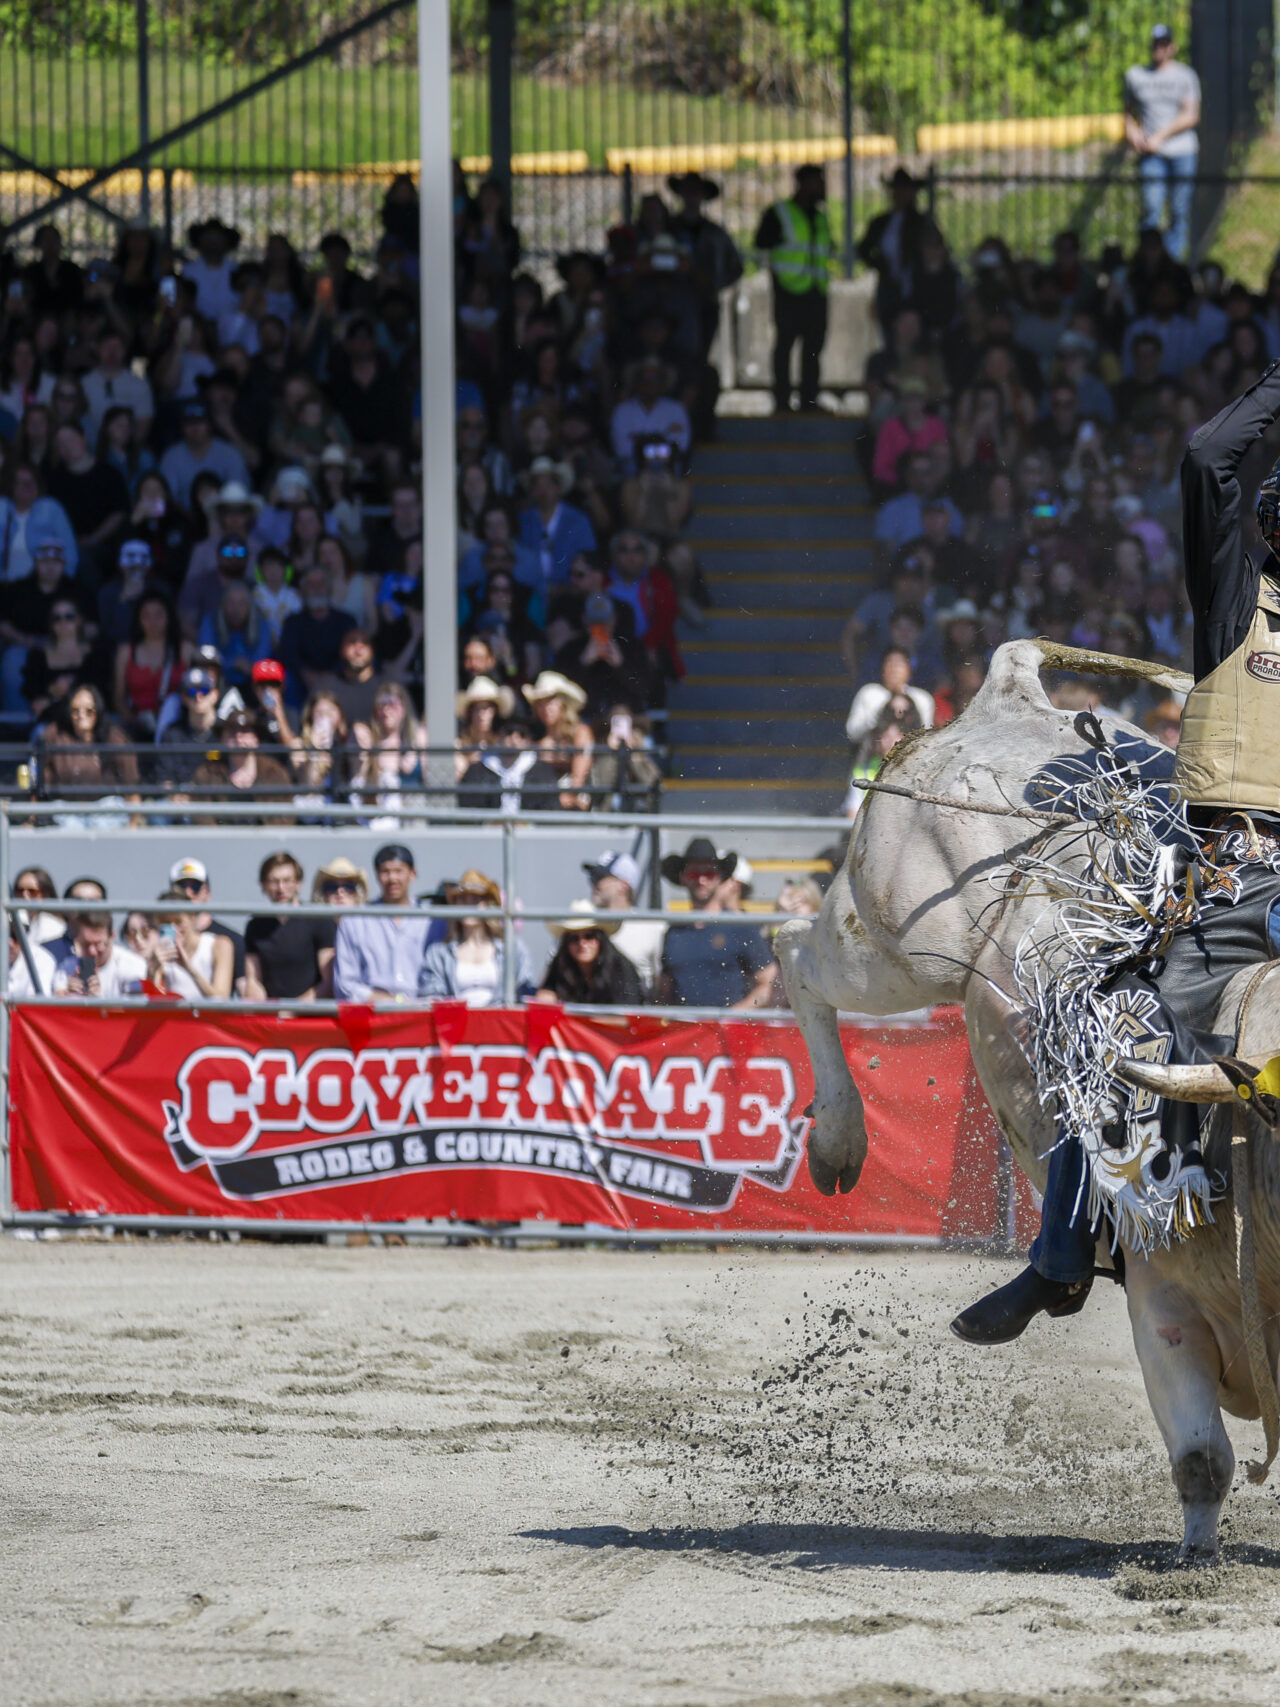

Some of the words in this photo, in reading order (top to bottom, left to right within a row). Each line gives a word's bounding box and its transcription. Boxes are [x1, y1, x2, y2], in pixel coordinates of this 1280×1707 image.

[184, 1048, 788, 1166] CLOVERDALE
[275, 1141, 395, 1184] RODEO
[403, 1136, 428, 1164] &
[608, 1153, 693, 1199] FAIR
